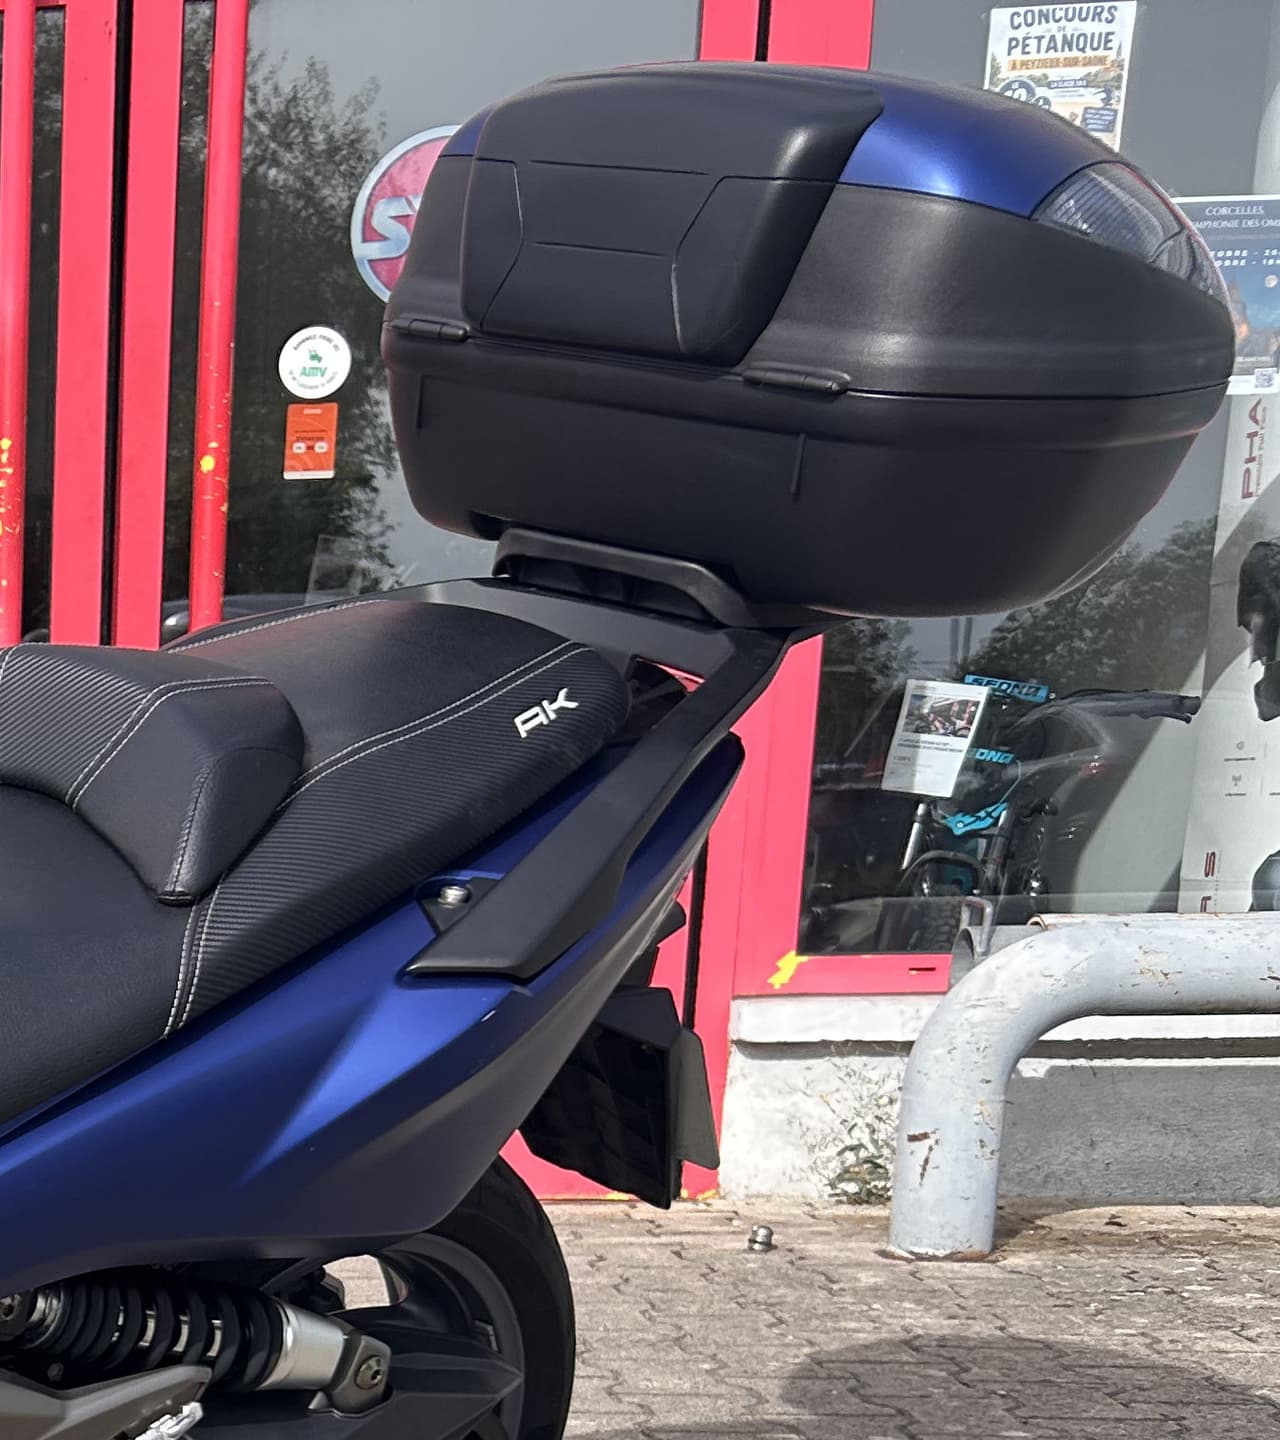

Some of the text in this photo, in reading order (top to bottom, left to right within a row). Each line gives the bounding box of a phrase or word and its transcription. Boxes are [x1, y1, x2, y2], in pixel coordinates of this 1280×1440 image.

[1009, 5, 1118, 30] CONCOURS
[1007, 31, 1116, 56] PÉTANQUE
[1205, 206, 1265, 216] CORCELLES
[513, 687, 580, 738] AK
